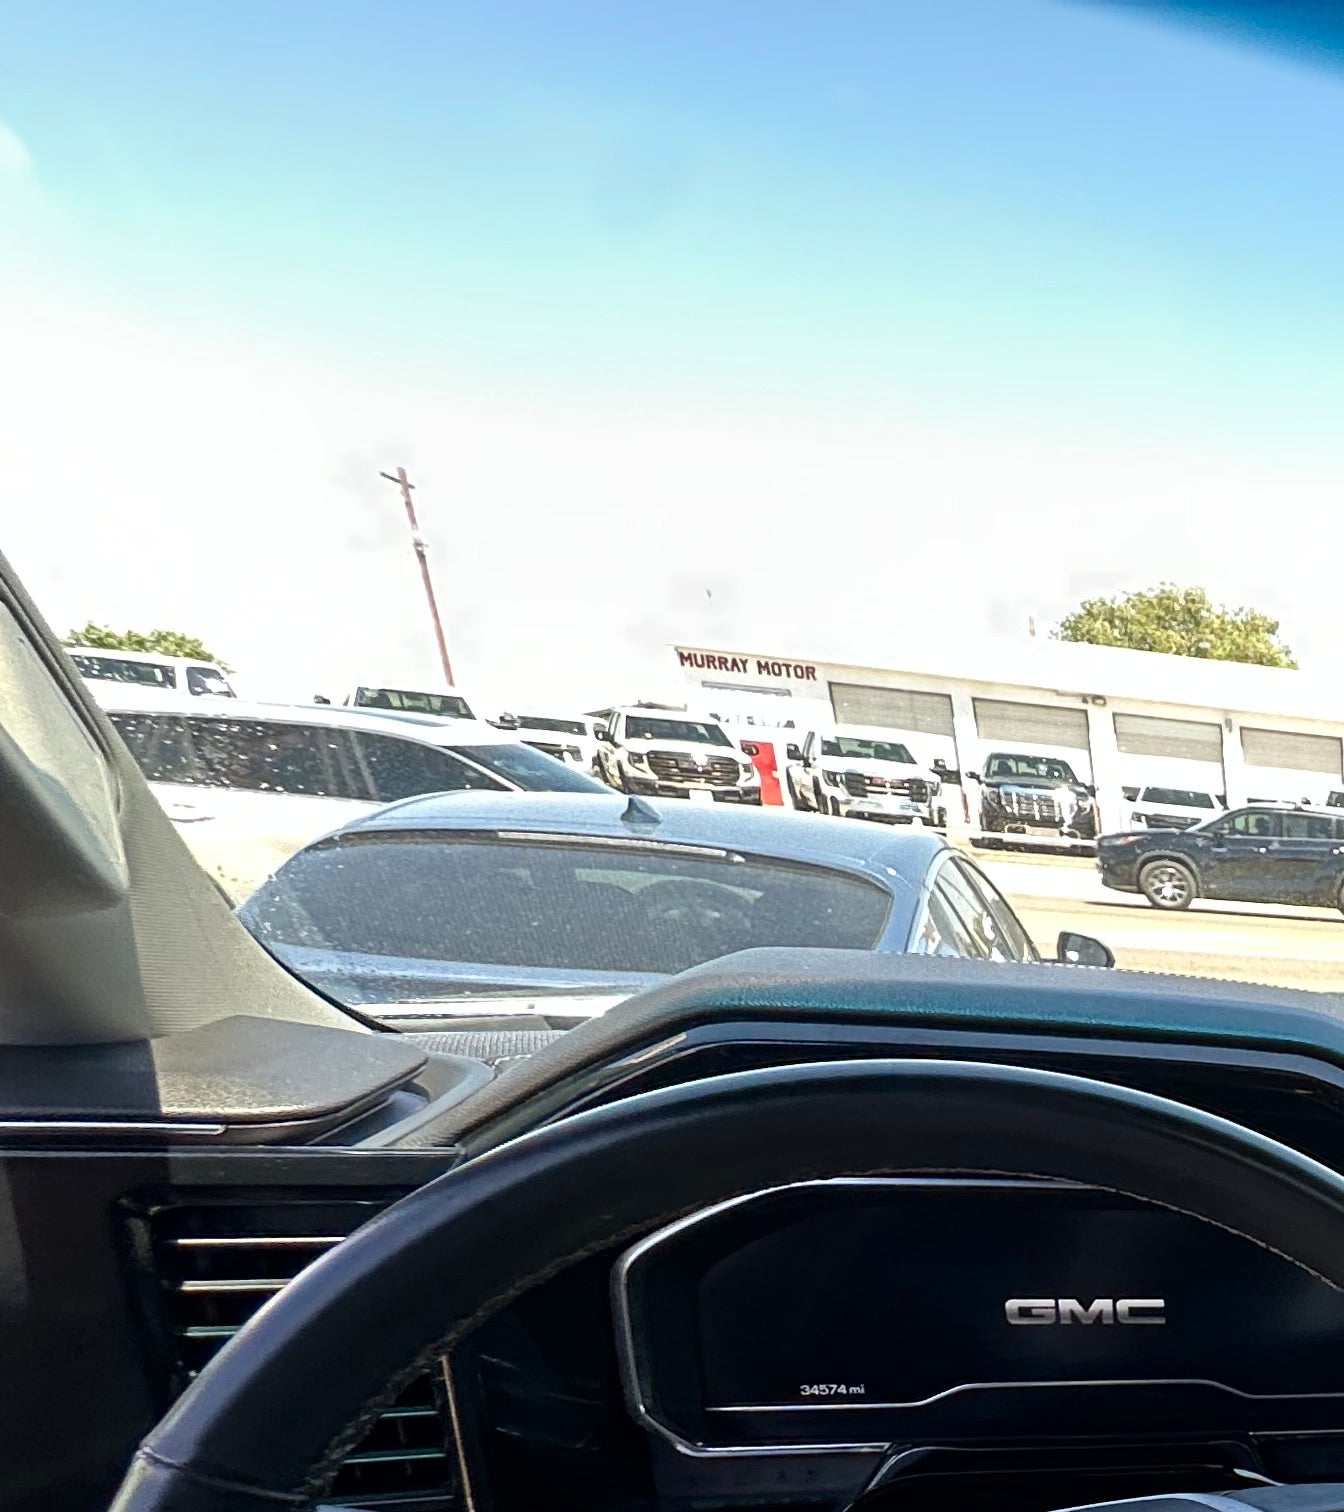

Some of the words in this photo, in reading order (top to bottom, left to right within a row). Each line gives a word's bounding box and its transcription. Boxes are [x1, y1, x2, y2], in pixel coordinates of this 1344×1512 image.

[678, 651, 749, 674] MURRAY
[756, 660, 817, 681] MOTOR
[1005, 1298, 1166, 1325] GMC
[800, 1384, 846, 1396] 34574
[849, 1384, 865, 1395] mi
